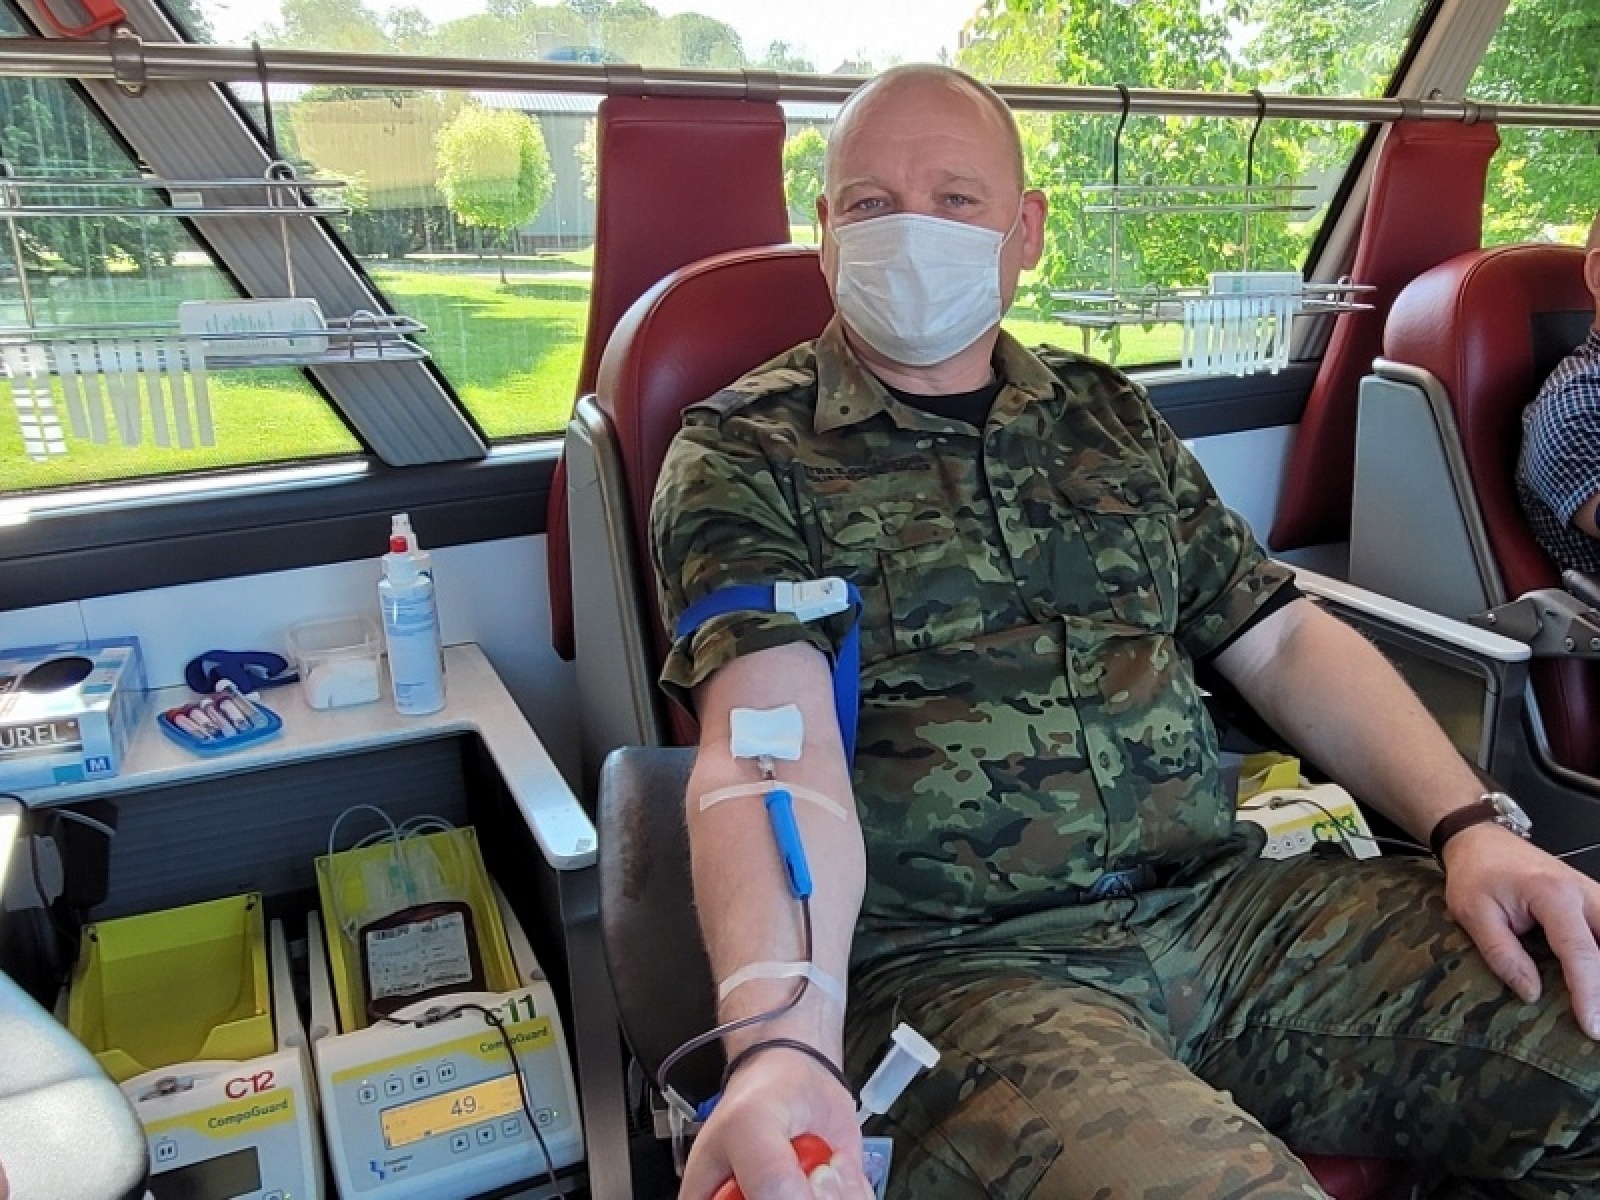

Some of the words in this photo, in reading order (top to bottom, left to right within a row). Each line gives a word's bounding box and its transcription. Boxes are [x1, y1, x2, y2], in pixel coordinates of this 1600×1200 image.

[88, 757, 107, 773] M
[225, 1069, 276, 1099] C12
[207, 1097, 289, 1129] CompoGuard
[451, 1095, 477, 1116] 49
